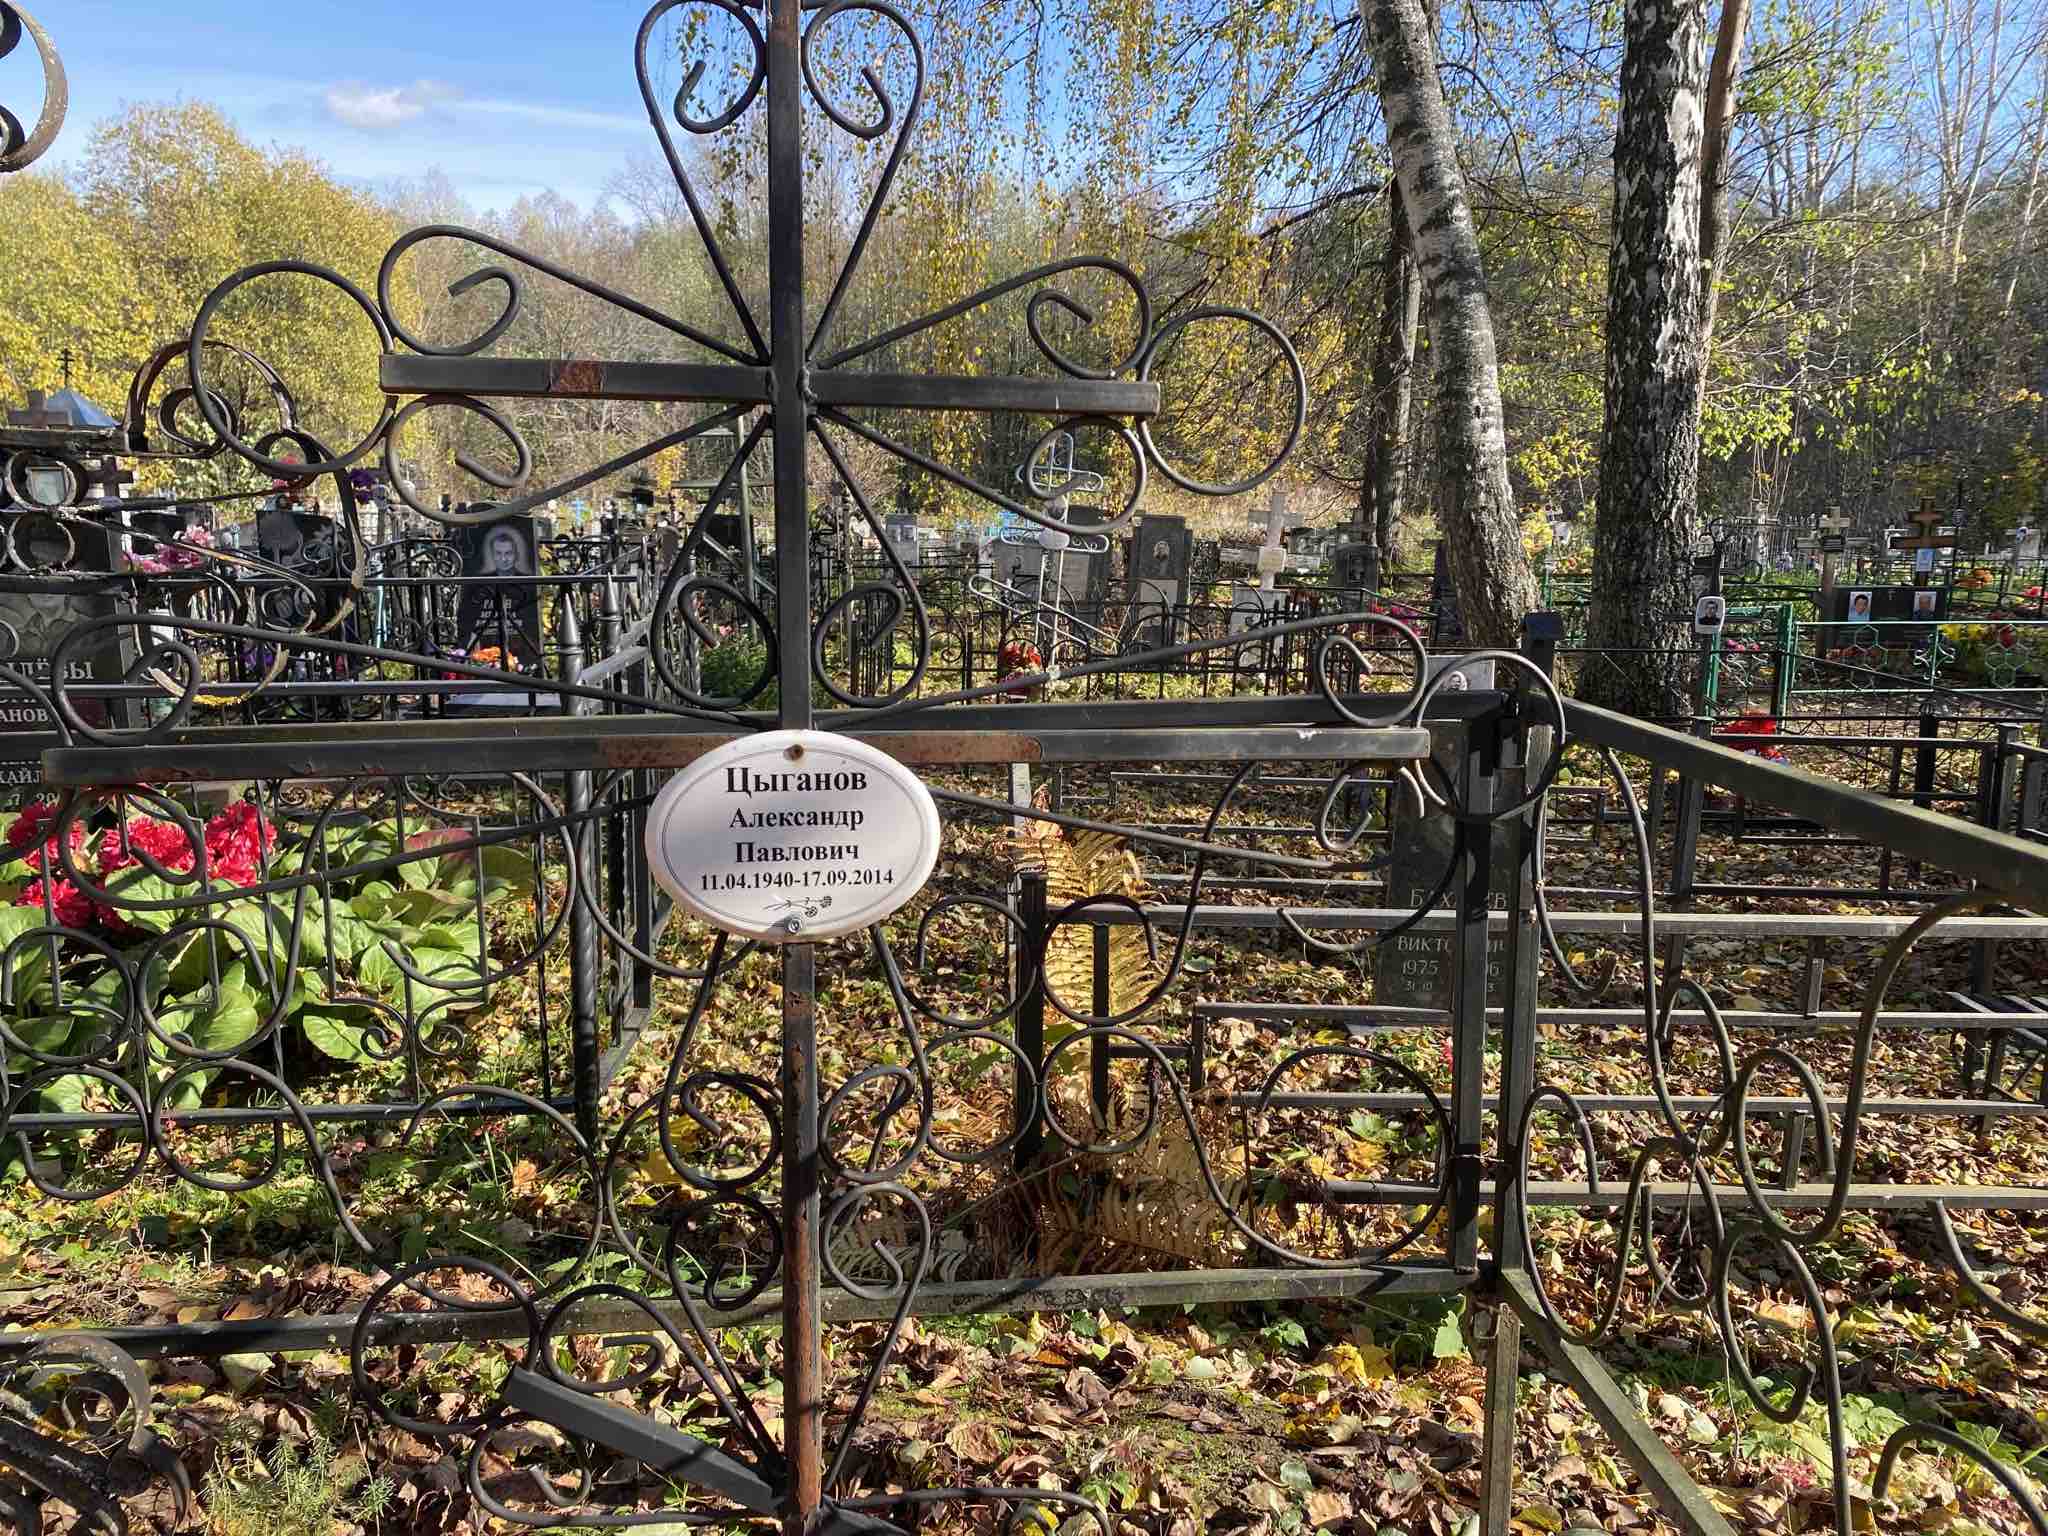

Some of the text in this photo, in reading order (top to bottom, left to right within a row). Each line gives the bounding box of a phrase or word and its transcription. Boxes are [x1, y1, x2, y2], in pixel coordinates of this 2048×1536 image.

[726, 767, 868, 798] Цыганов
[729, 807, 865, 831] Александр
[735, 841, 860, 863] Павлович
[700, 868, 894, 891] 11.04.1940-17.09.2014
[1402, 959, 1440, 976] 1975
